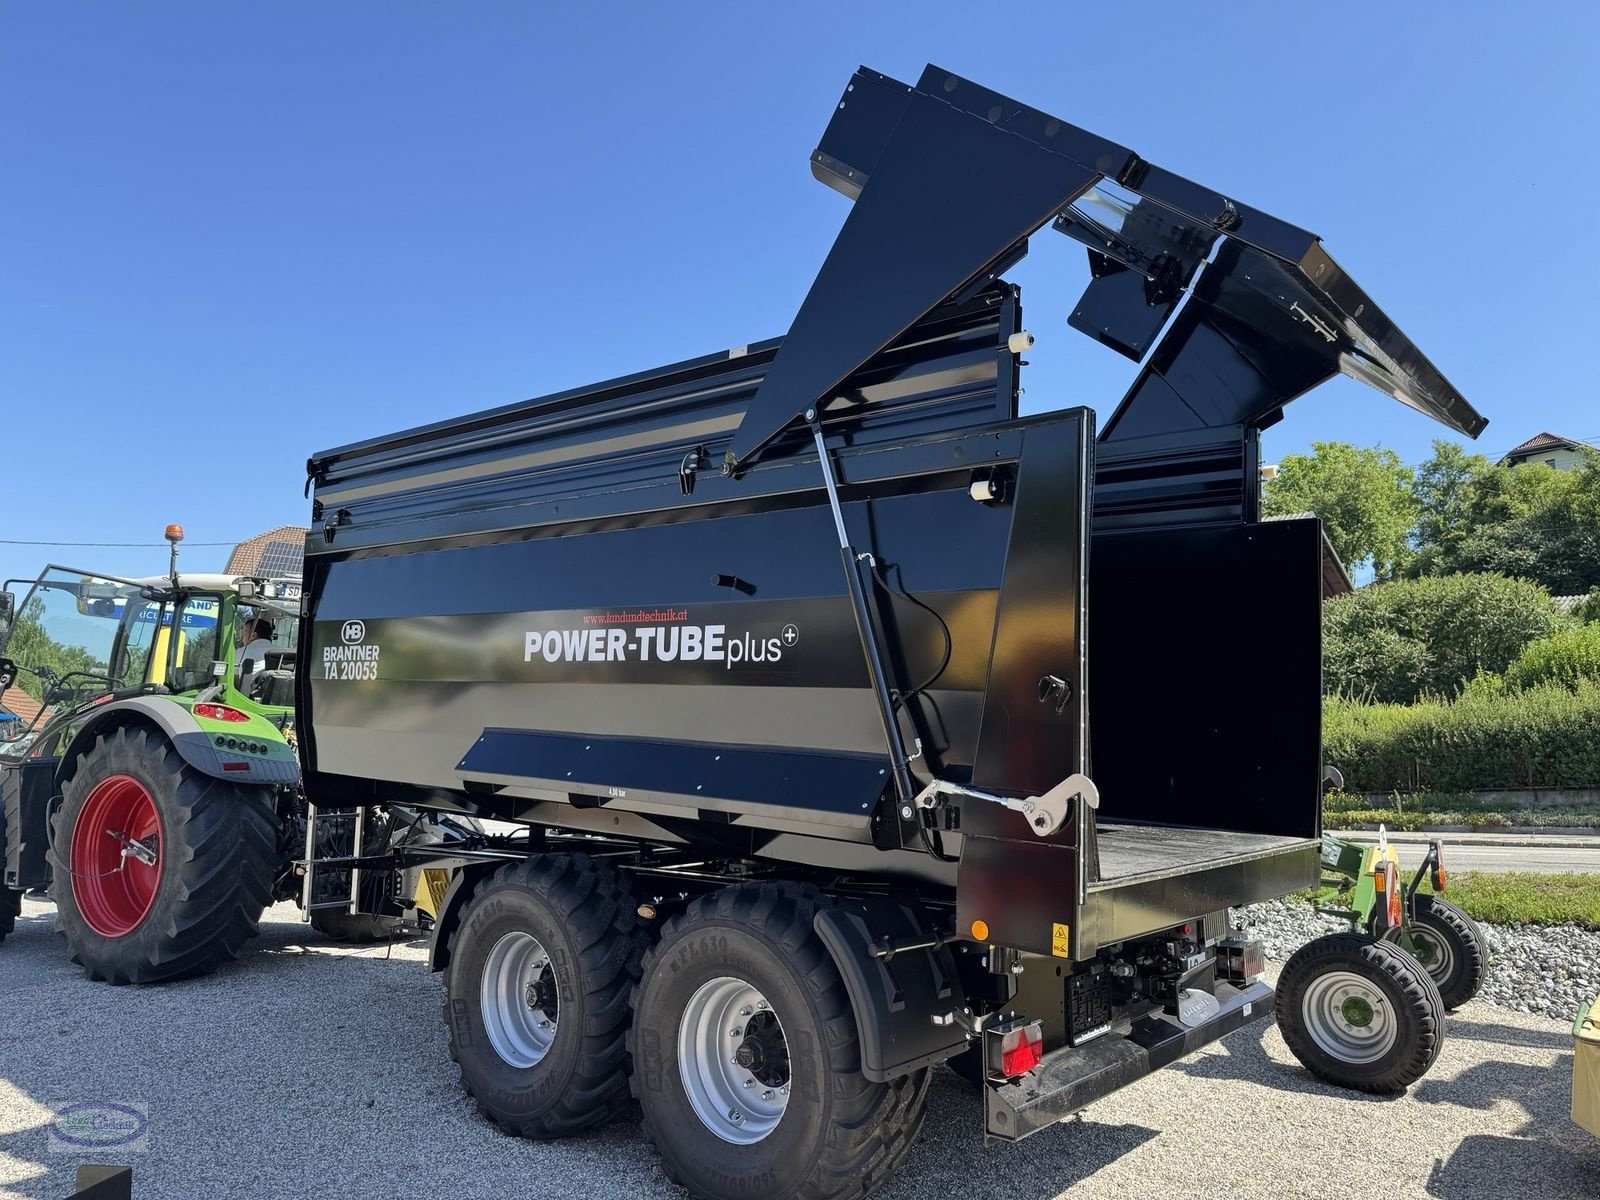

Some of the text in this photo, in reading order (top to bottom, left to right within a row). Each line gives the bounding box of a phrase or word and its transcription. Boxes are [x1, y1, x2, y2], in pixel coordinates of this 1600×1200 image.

[583, 609, 688, 624] www.landundtechnik.at
[524, 624, 726, 662] POWER-TUBE
[323, 645, 380, 661] BRANTNER
[324, 661, 378, 680] TA 20053
